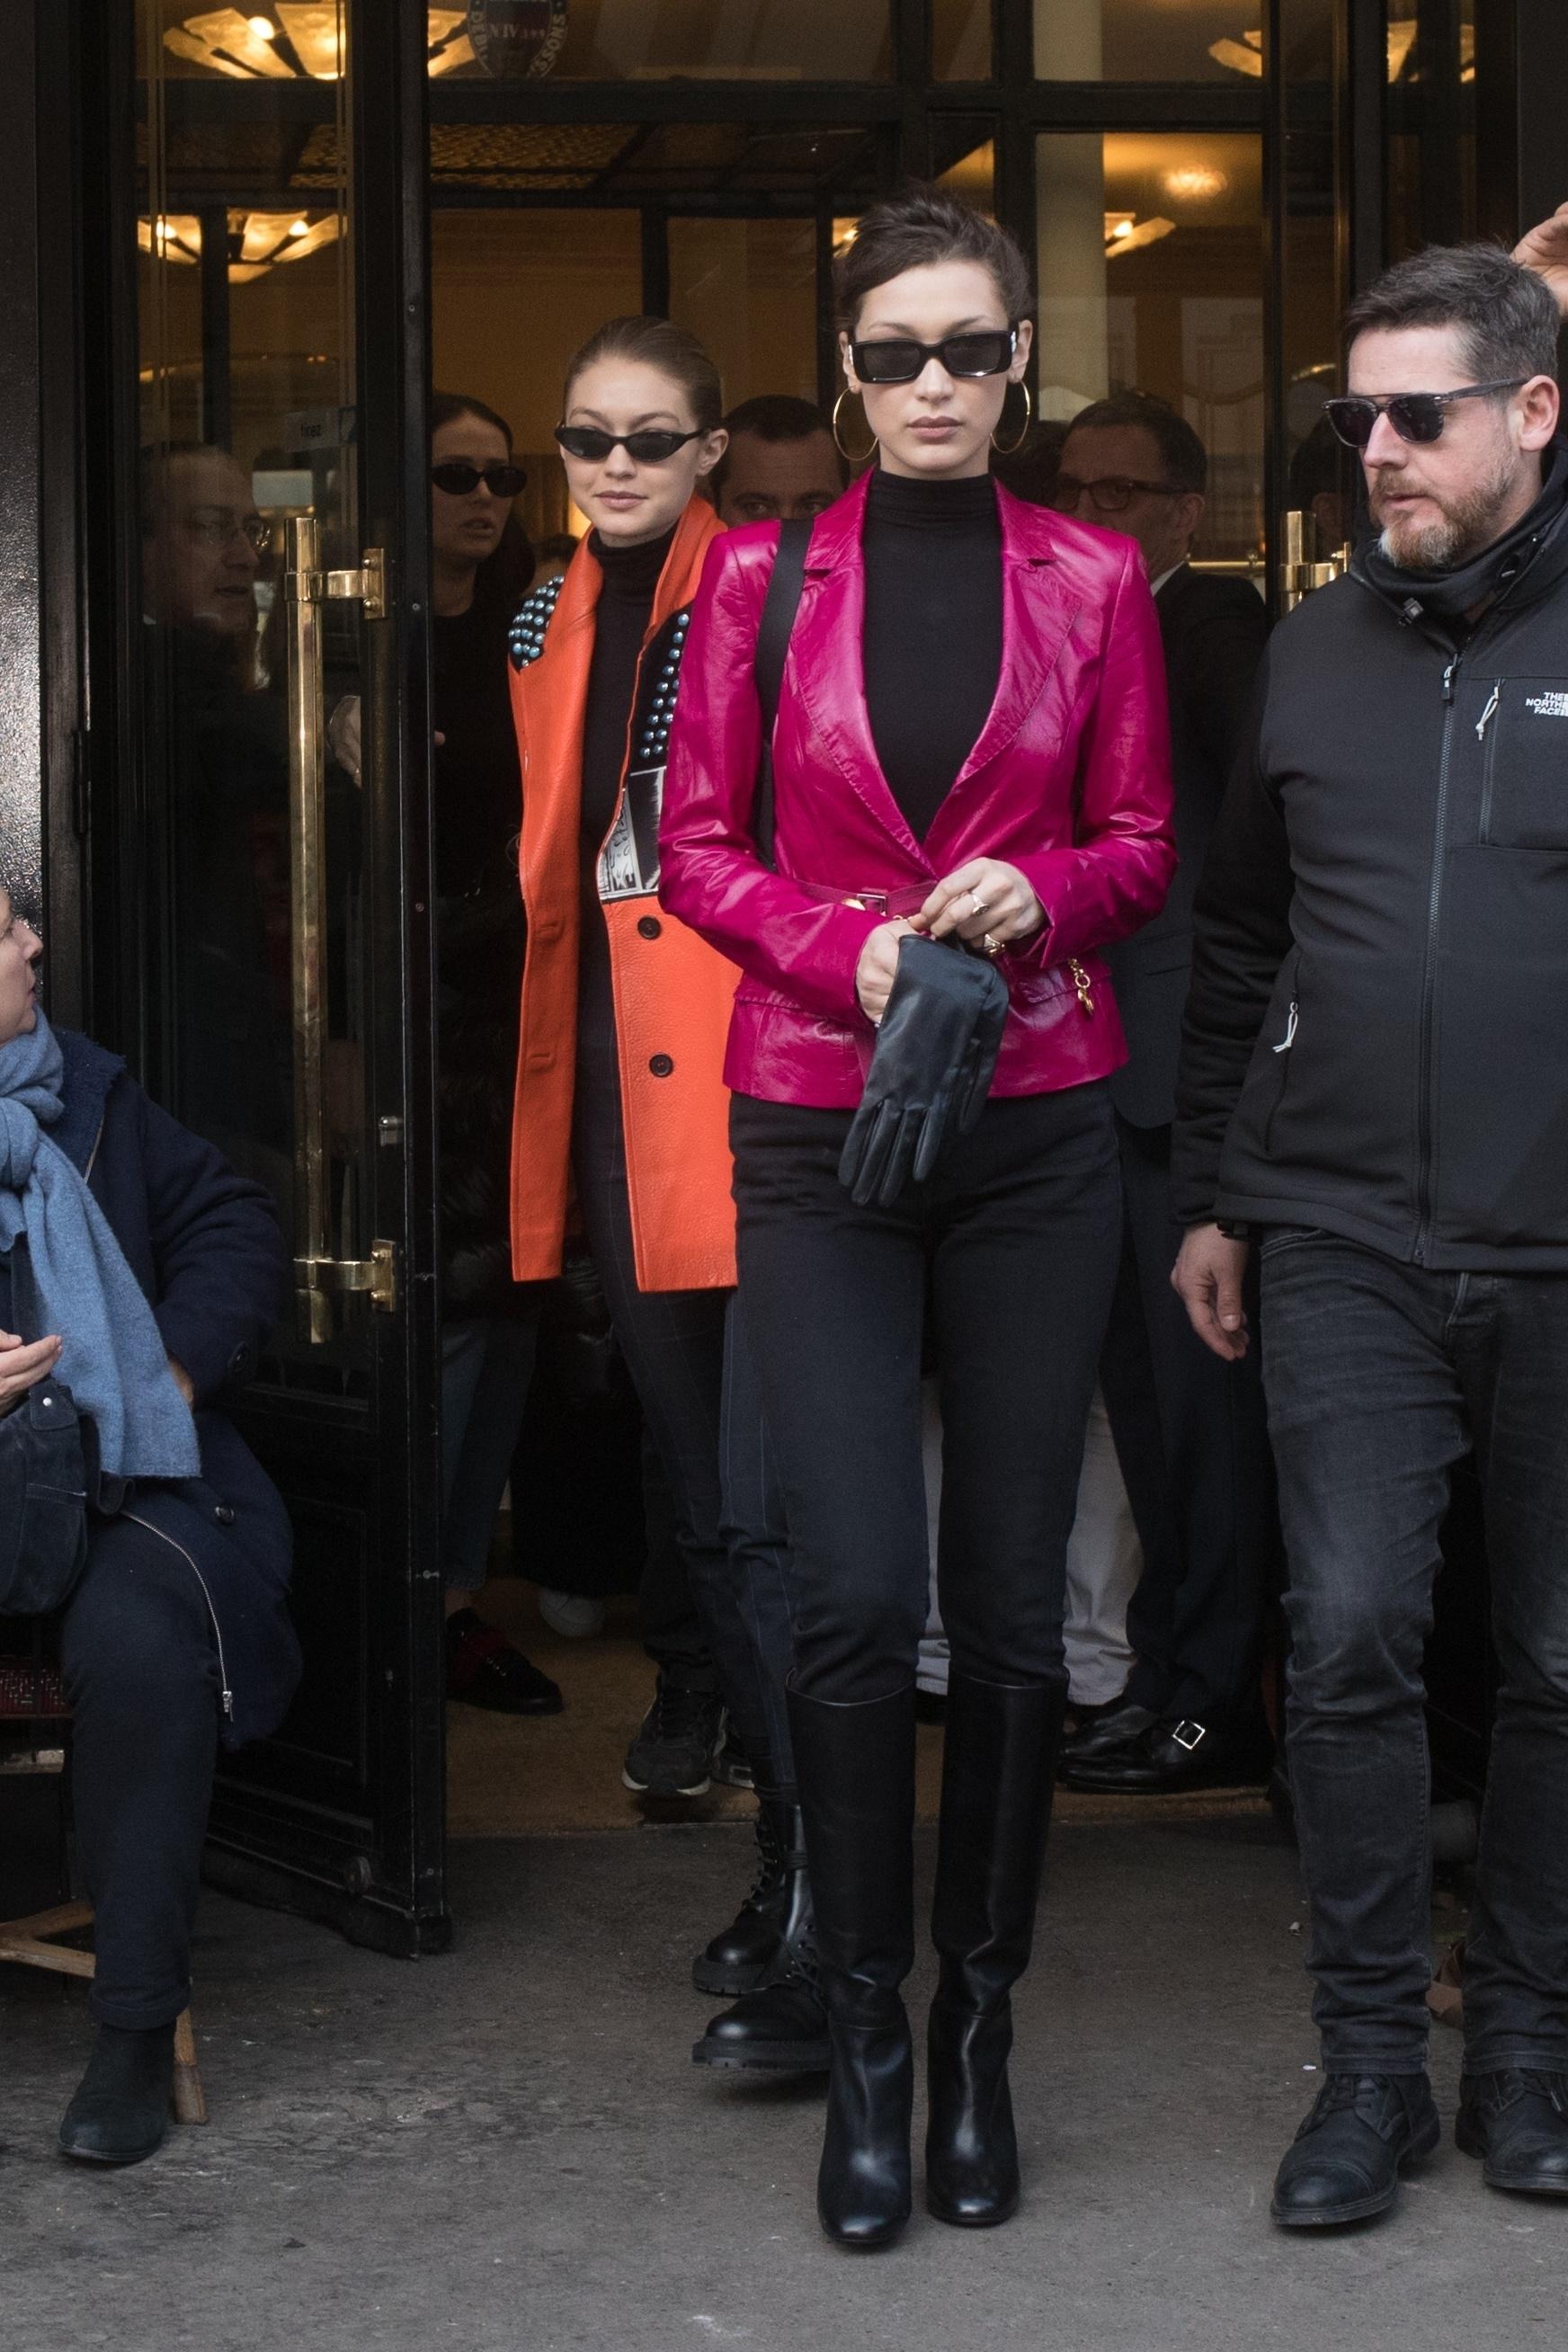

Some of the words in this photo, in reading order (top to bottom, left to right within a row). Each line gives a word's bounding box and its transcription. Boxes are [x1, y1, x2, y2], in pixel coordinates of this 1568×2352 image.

[1544, 691, 1564, 701] THE
[1525, 698, 1563, 708] NORTH
[1534, 707, 1560, 716] FACE
